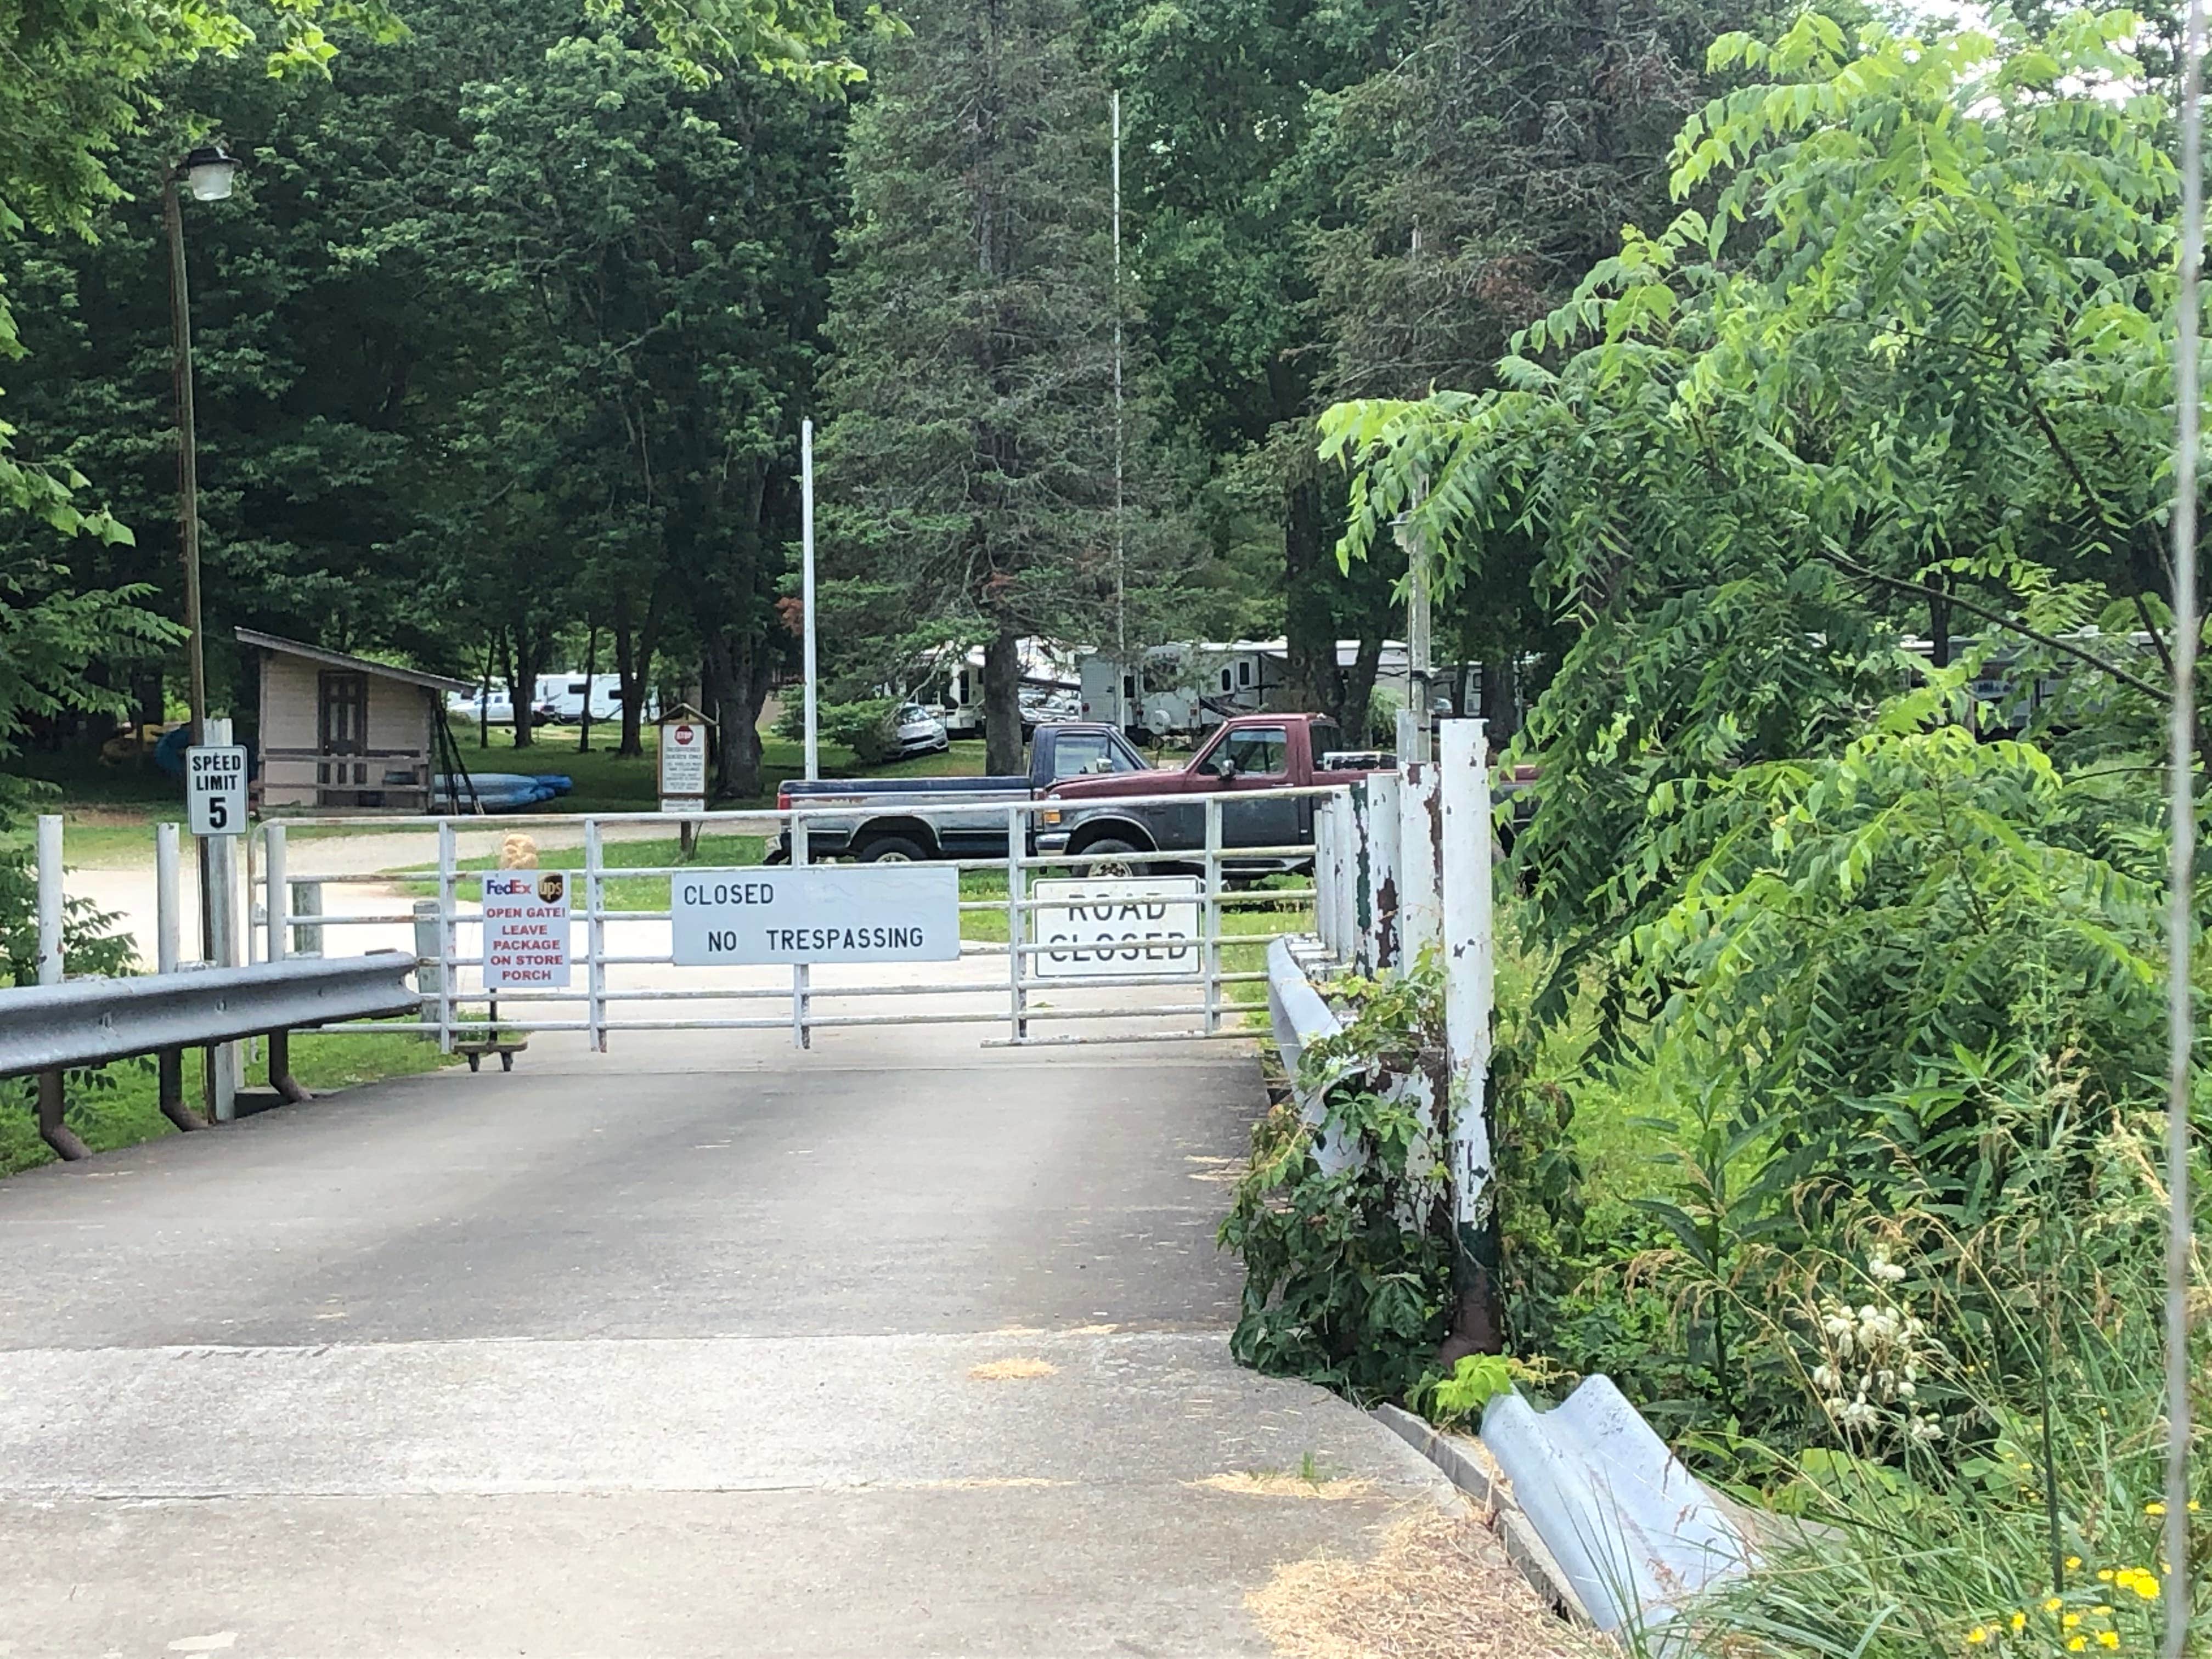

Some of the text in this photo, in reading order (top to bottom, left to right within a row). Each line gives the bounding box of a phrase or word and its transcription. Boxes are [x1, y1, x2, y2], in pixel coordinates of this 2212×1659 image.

[193, 755, 241, 771] SPEED
[196, 775, 238, 791] LIMIT
[209, 797, 227, 828] 5
[487, 879, 531, 895] FedEx
[539, 881, 562, 900] ups
[684, 883, 774, 906] CLOSED
[487, 907, 566, 918] OPEN GATE!
[1068, 893, 1166, 922] ROAD
[502, 925, 548, 935] LEAVE
[493, 940, 560, 950] PACKAGE
[708, 928, 923, 952] NO TRESPASSING
[1049, 932, 1188, 961] CLOSED
[490, 955, 563, 965] ON STORE
[502, 970, 551, 980] PORCH
